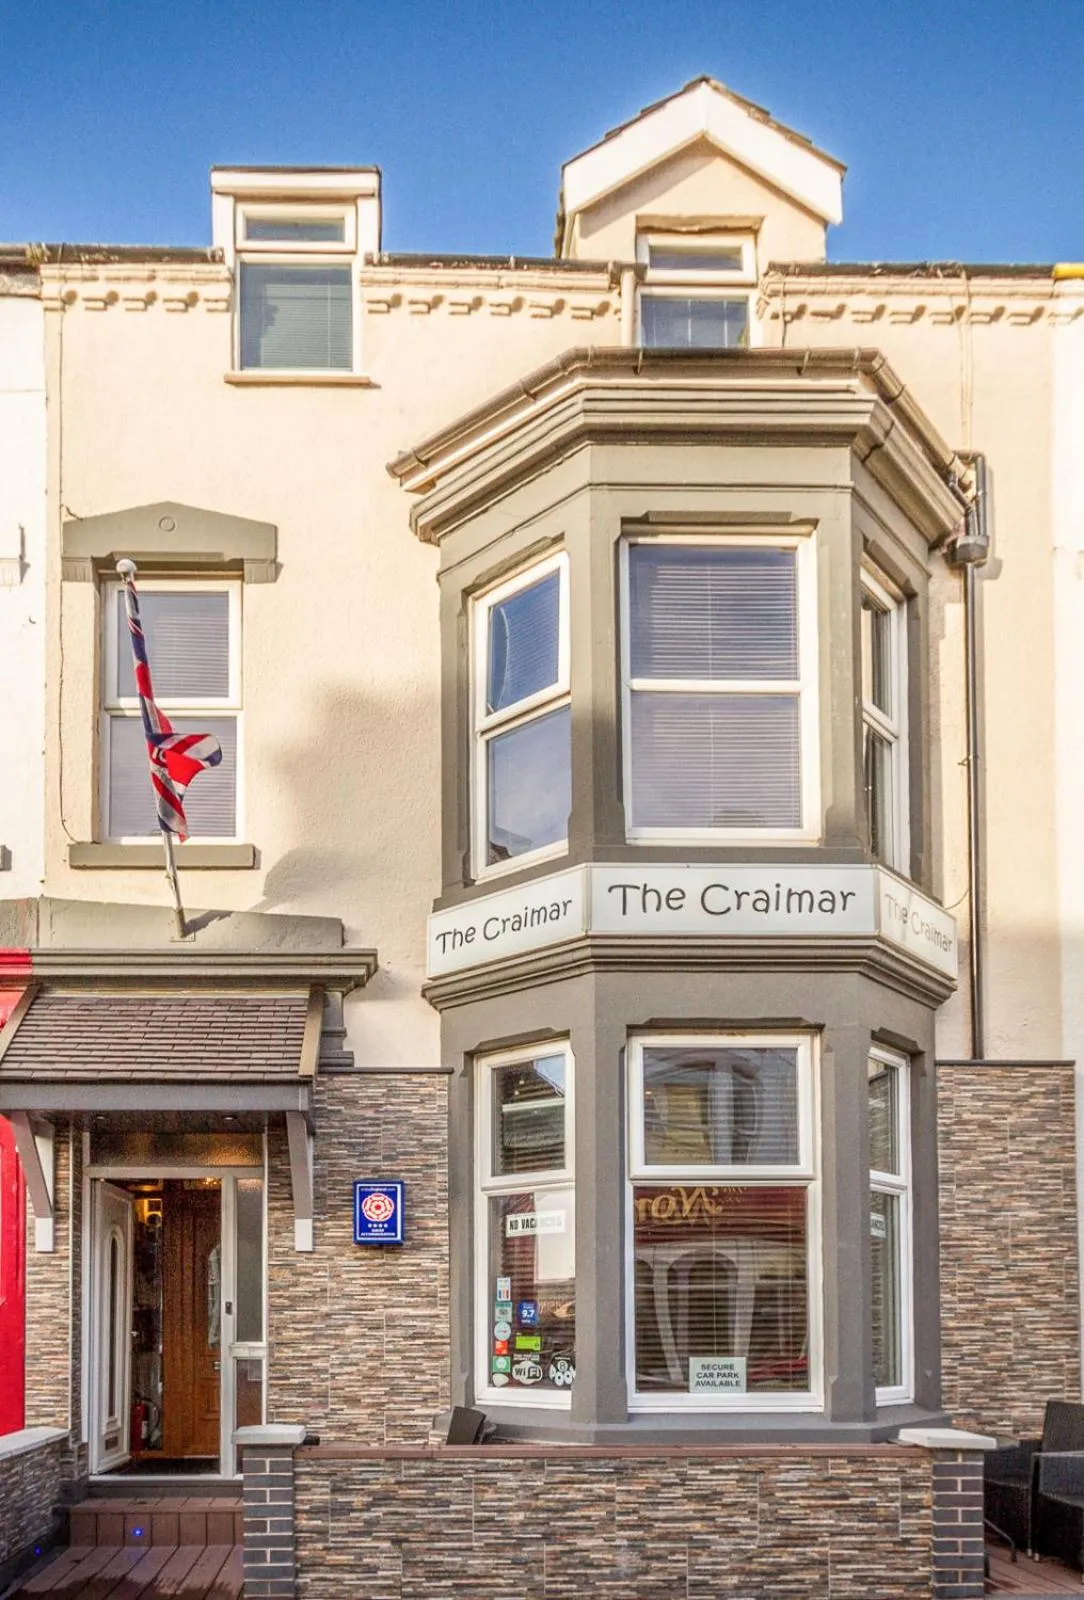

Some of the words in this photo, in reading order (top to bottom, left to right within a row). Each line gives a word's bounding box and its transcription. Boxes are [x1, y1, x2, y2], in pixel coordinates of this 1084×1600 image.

[608, 883, 686, 917] The
[699, 882, 856, 917] Craimar
[436, 926, 476, 955] The
[483, 899, 573, 941] Craimar
[884, 894, 908, 925] The
[911, 911, 953, 952] Craimar
[509, 1219, 519, 1231] NO
[522, 1309, 535, 1318] 9.7
